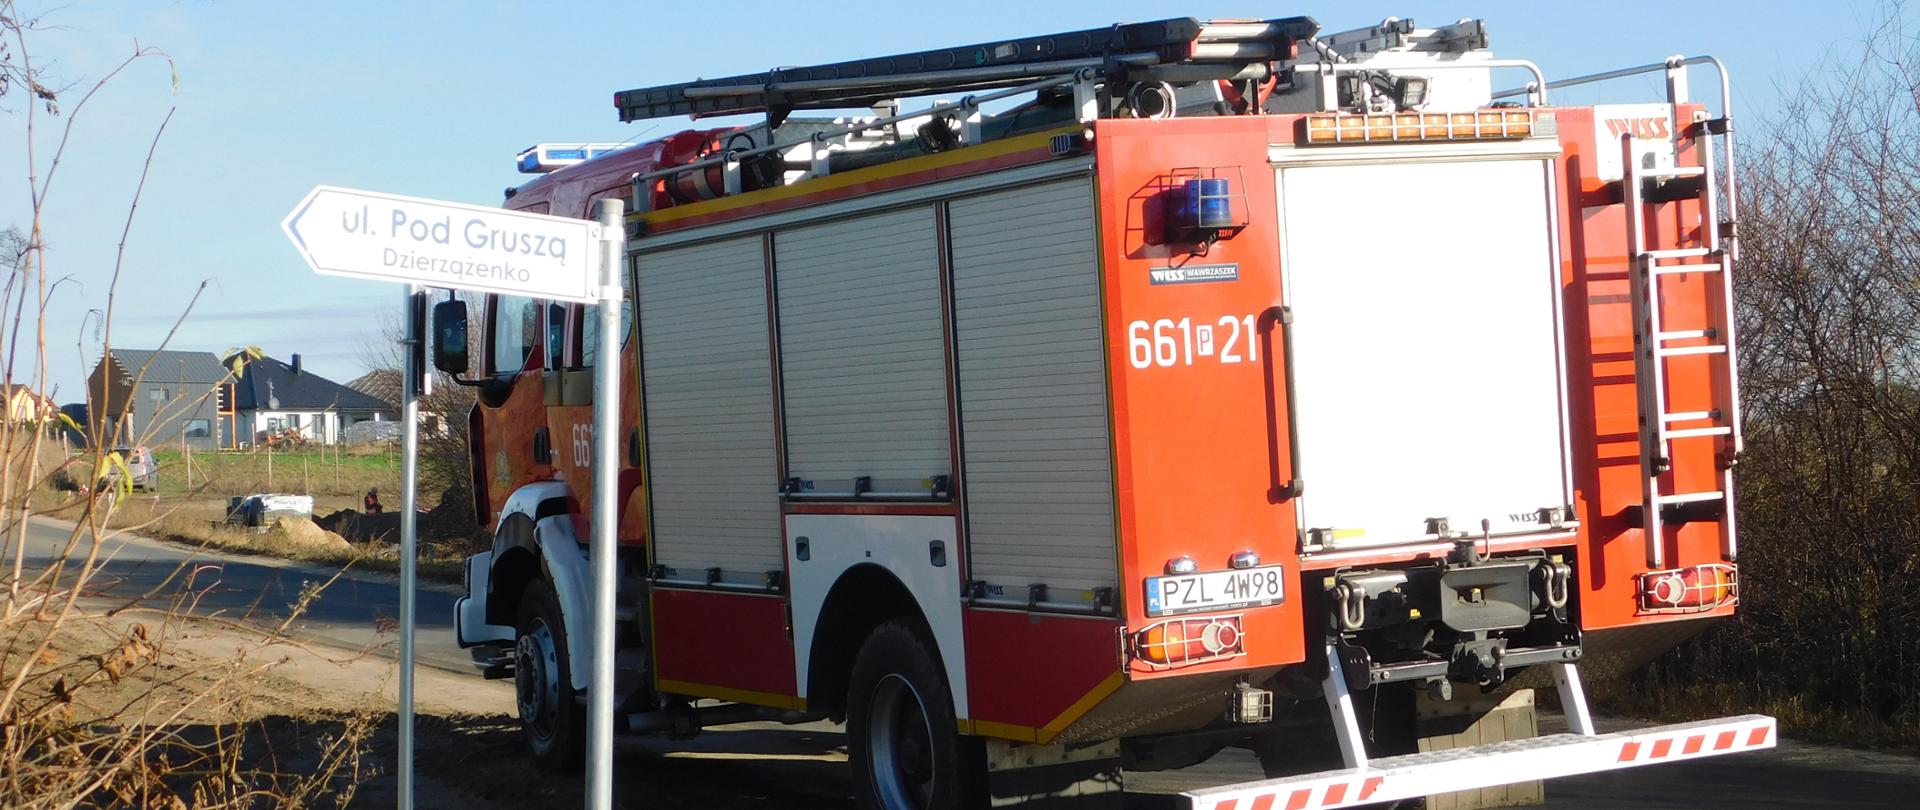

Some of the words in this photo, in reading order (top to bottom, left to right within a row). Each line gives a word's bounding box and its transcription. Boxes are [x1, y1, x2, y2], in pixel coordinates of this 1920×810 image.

[1604, 117, 1669, 140] WISS
[342, 204, 376, 236] ul.
[391, 208, 450, 245] Pod
[463, 218, 567, 266] Gruszą
[383, 247, 531, 283] Dzierzążenko
[1151, 269, 1185, 281] WISS
[1186, 267, 1236, 277] WAWRZASZEK
[1128, 317, 1193, 369] 661
[1217, 314, 1257, 364] 21
[1508, 512, 1538, 522] WISS
[1163, 578, 1214, 606] PZL
[1224, 570, 1279, 600] 4W98
